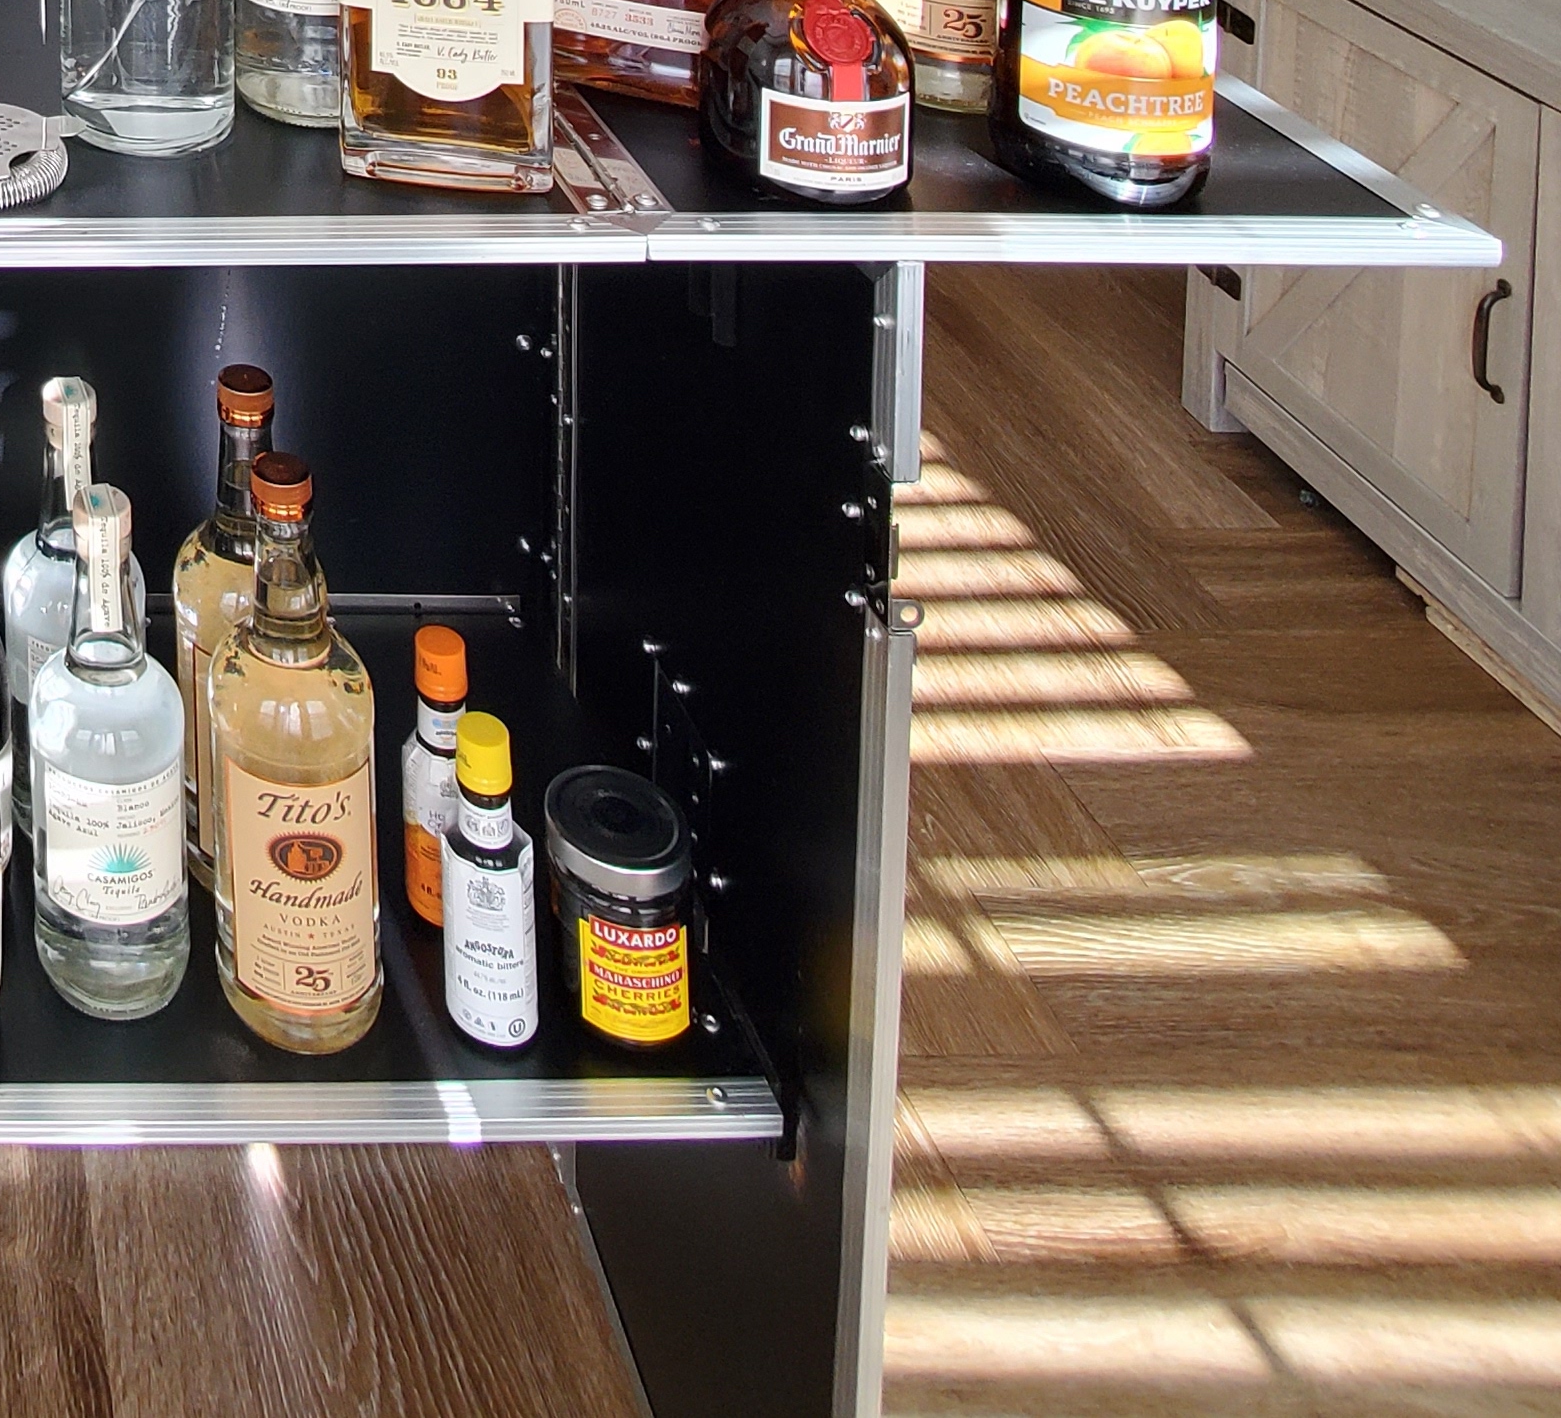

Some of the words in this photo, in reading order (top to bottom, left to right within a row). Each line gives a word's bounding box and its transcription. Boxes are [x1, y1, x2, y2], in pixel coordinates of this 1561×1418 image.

[1067, 1, 1091, 10] SINCE
[943, 9, 984, 39] 25
[437, 46, 446, 57] V.
[436, 68, 458, 80] 93
[1047, 78, 1203, 116] PEACHTREE
[1089, 111, 1124, 124] PEACH
[779, 127, 835, 155] Grand
[835, 133, 901, 156] Marnier
[73, 403, 81, 438] Tequila
[100, 515, 109, 555] Tequila
[101, 598, 110, 628] Agave
[117, 801, 150, 813] Blanco
[48, 809, 71, 827] Agave
[76, 825, 99, 837] Azul
[86, 818, 110, 830] 100%
[87, 869, 154, 885] CASAMIGOS
[102, 885, 140, 898] Tequila
[249, 870, 363, 909] Handmade
[264, 924, 301, 938] AUSTIN
[323, 924, 355, 938] TEXAS
[280, 913, 341, 927] VODKA
[594, 921, 677, 948] LUXARDO
[456, 945, 493, 969] aromatic
[497, 959, 524, 970] bitters
[465, 939, 514, 959] ANGOSTURA
[295, 965, 331, 992] 25
[594, 966, 679, 988] MARASCHINO
[458, 975, 462, 986] 4
[474, 988, 486, 998] oz.
[488, 990, 508, 1002] (118
[509, 988, 524, 999] mL)
[594, 979, 680, 1001] CHERRIES
